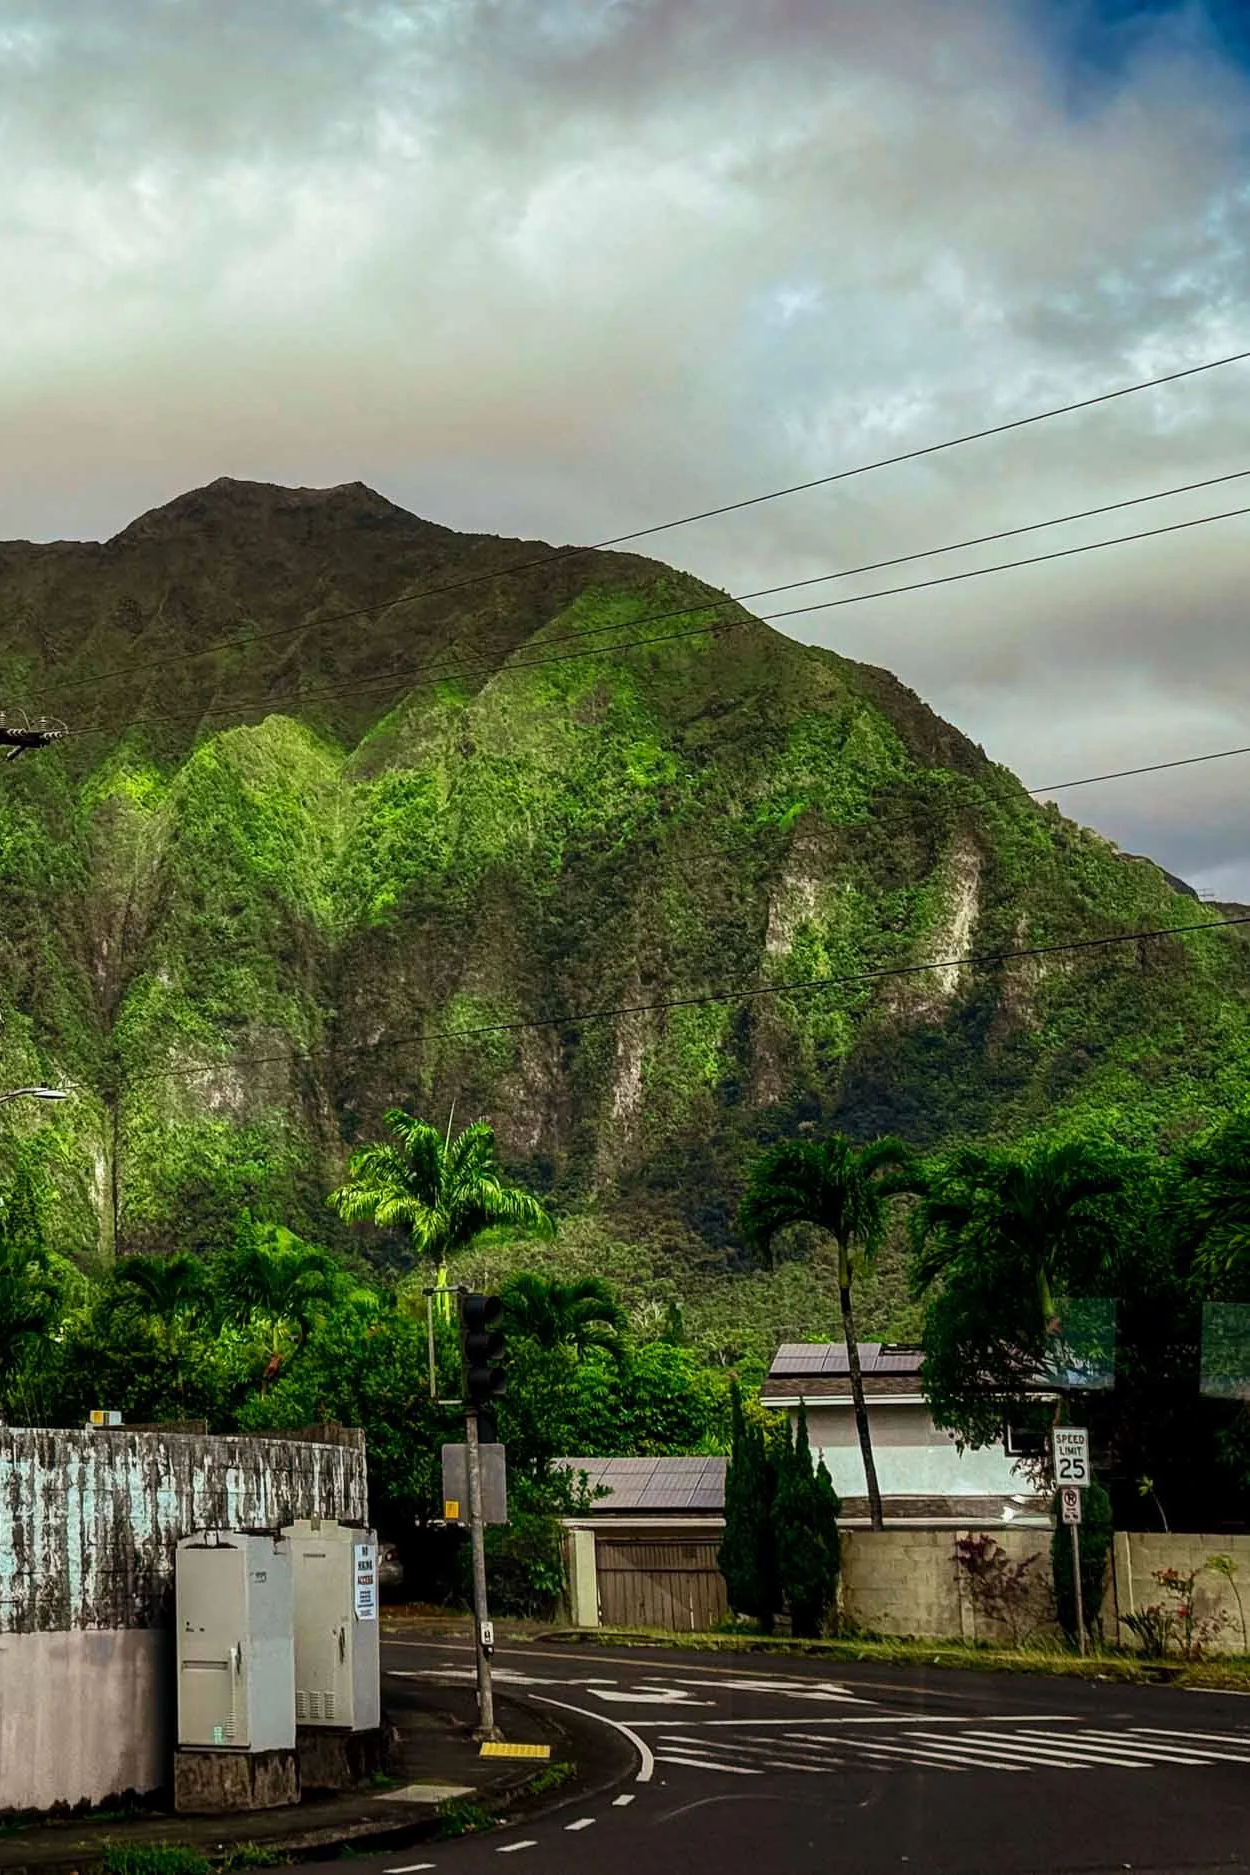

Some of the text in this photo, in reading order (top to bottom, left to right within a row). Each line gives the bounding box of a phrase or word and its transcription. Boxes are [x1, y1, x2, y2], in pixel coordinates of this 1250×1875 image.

[1056, 1434, 1084, 1444] SPEED
[1059, 1446, 1081, 1456] LIMIT
[1060, 1458, 1085, 1478] 25
